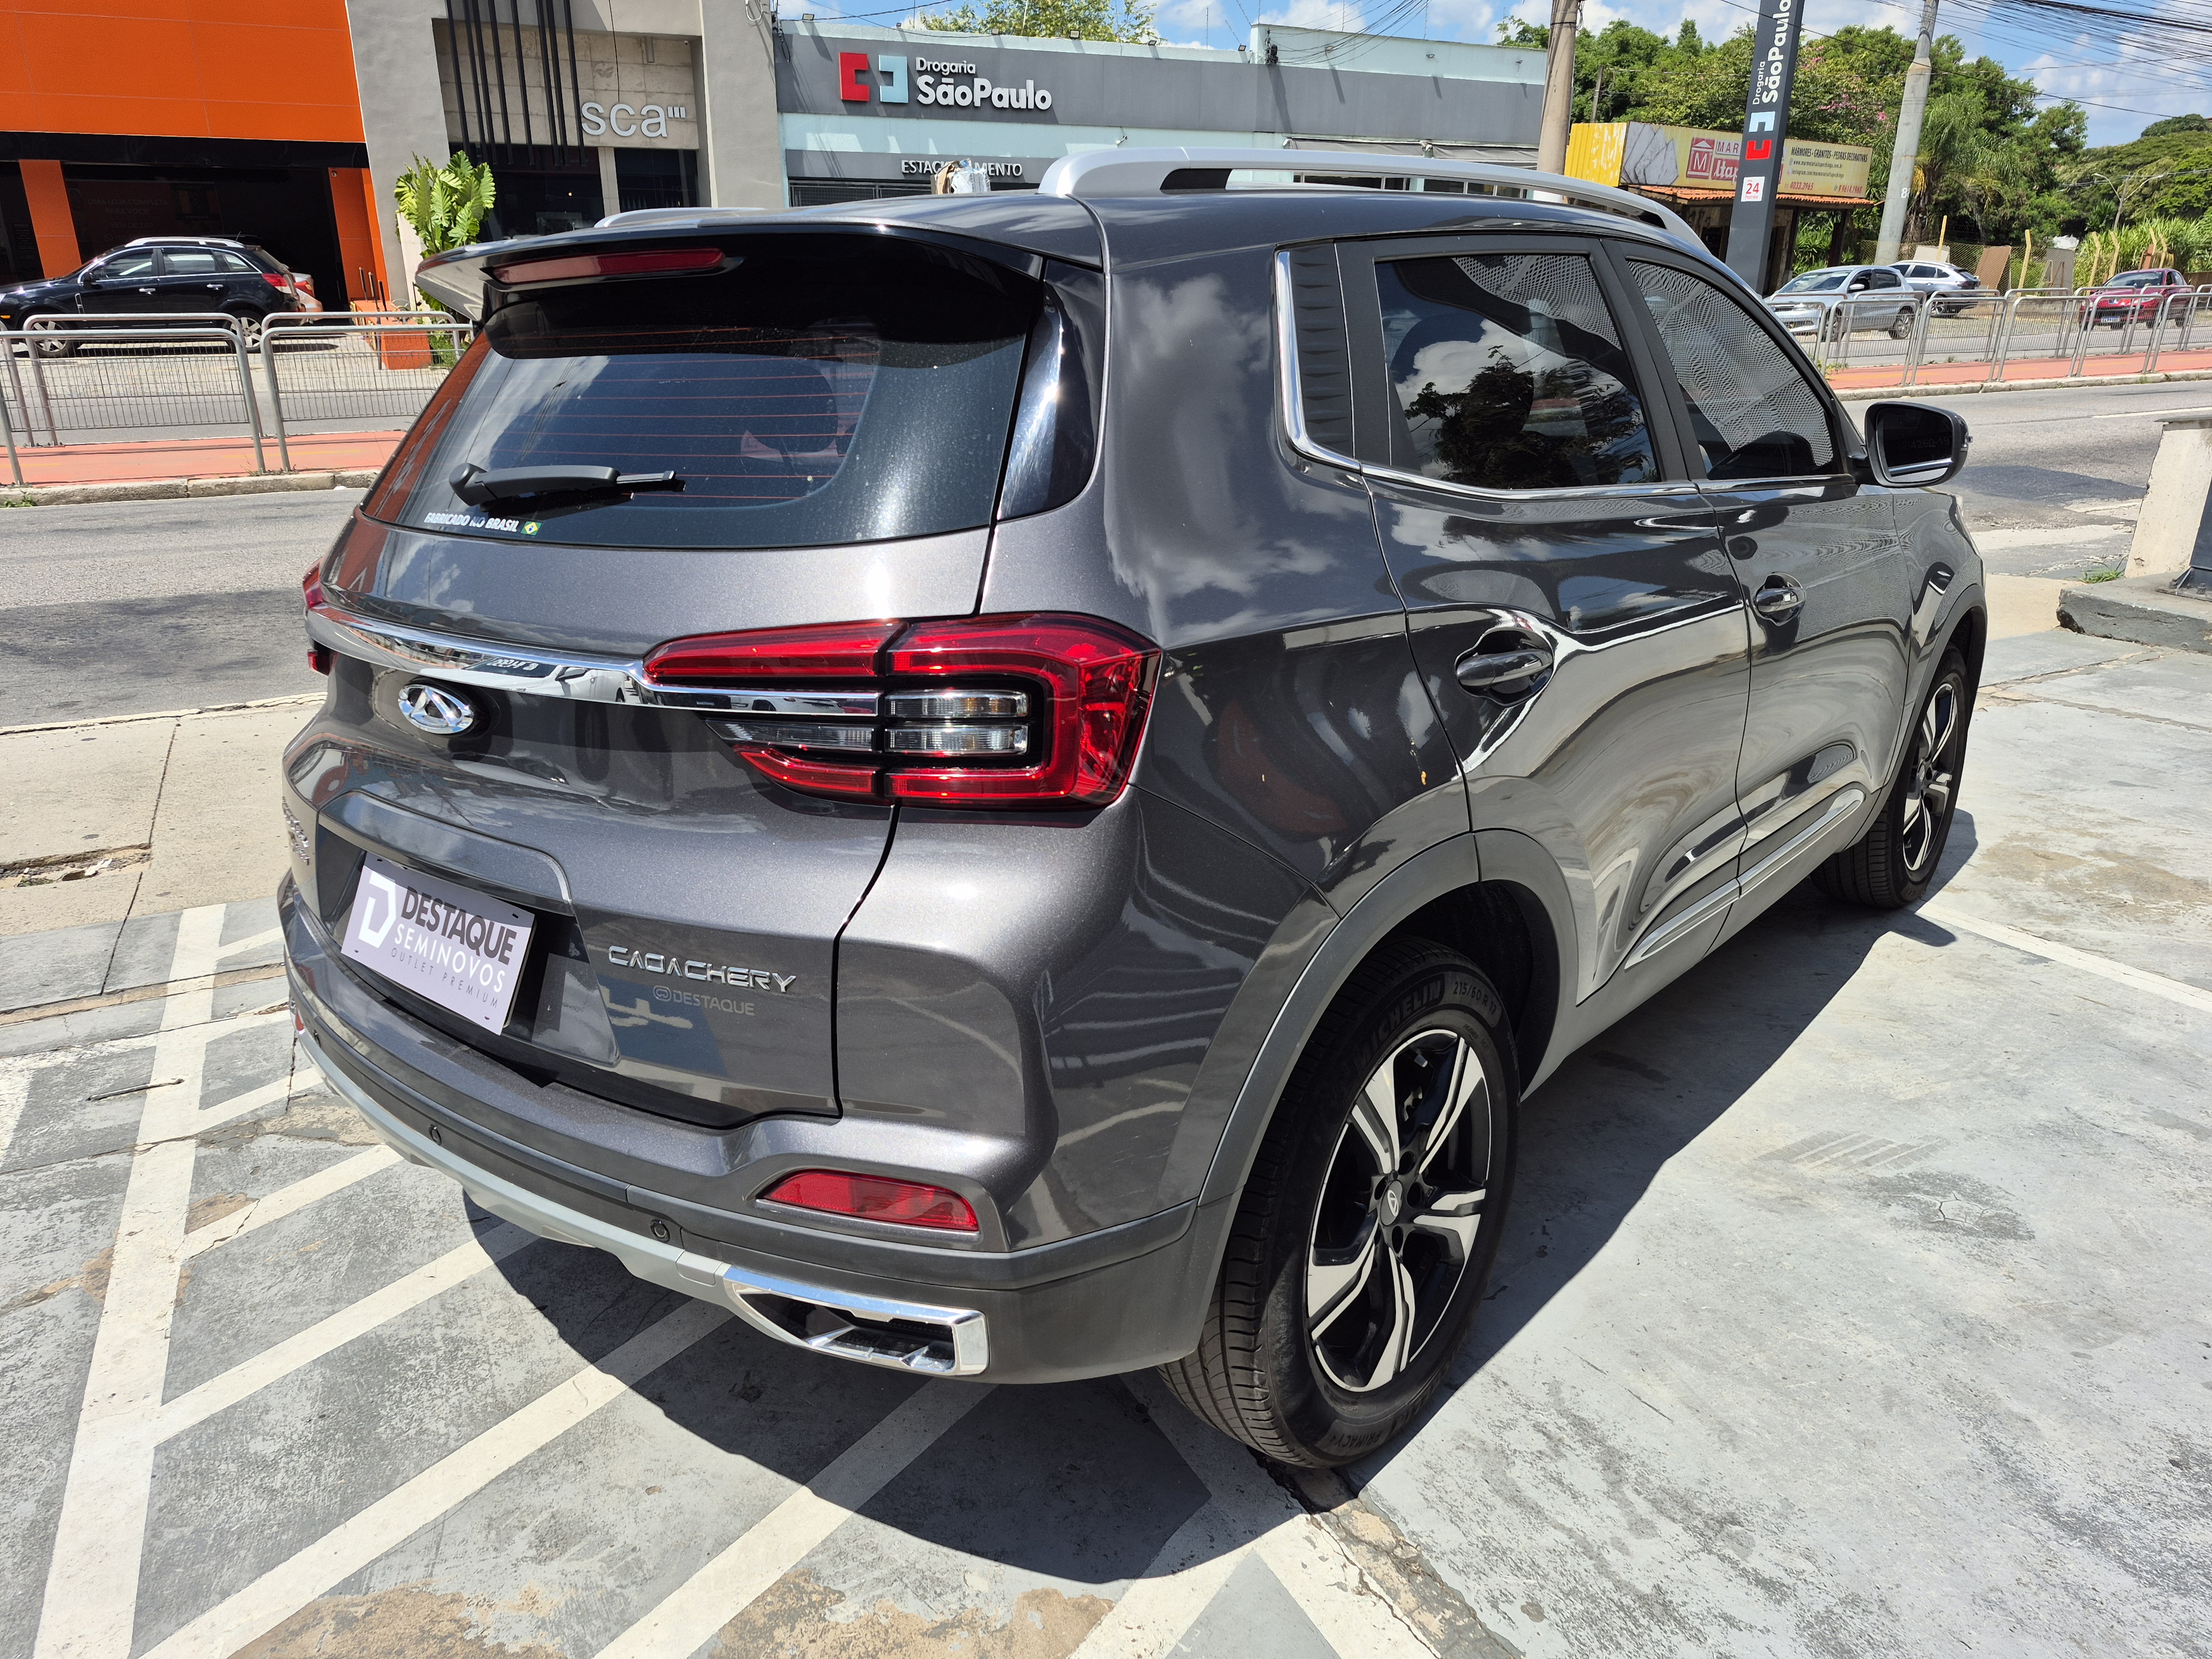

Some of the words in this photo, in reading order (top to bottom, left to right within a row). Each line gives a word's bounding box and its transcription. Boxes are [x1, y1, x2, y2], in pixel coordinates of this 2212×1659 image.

[915, 57, 976, 76] Drogaria
[1761, 0, 1792, 103] SãoPaulo
[916, 74, 1052, 110] SãoPaulo
[1752, 61, 1766, 105] Drogaria
[581, 102, 668, 138] sca
[1791, 145, 1812, 157] MÁRMORES
[1813, 149, 1832, 159] GRANITOS
[1833, 150, 1847, 160] PEDRAS
[1846, 152, 1869, 163] DECORATIVAS
[1745, 182, 1760, 194] 24
[1790, 181, 1814, 191] 4033.3965
[424, 512, 471, 526] FABRICADO
[469, 516, 486, 528] NO
[484, 518, 519, 533] BRASIL
[400, 885, 518, 966] DESTAQUE
[394, 923, 505, 993] SEMINOVOS
[390, 947, 434, 976] OUTLET
[442, 972, 498, 1009] PREMIUM
[1453, 981, 1482, 1001] 215/60
[1482, 996, 1489, 1005] R
[1489, 1001, 1497, 1014] 17
[1334, 1430, 1383, 1448] PRIMACY
